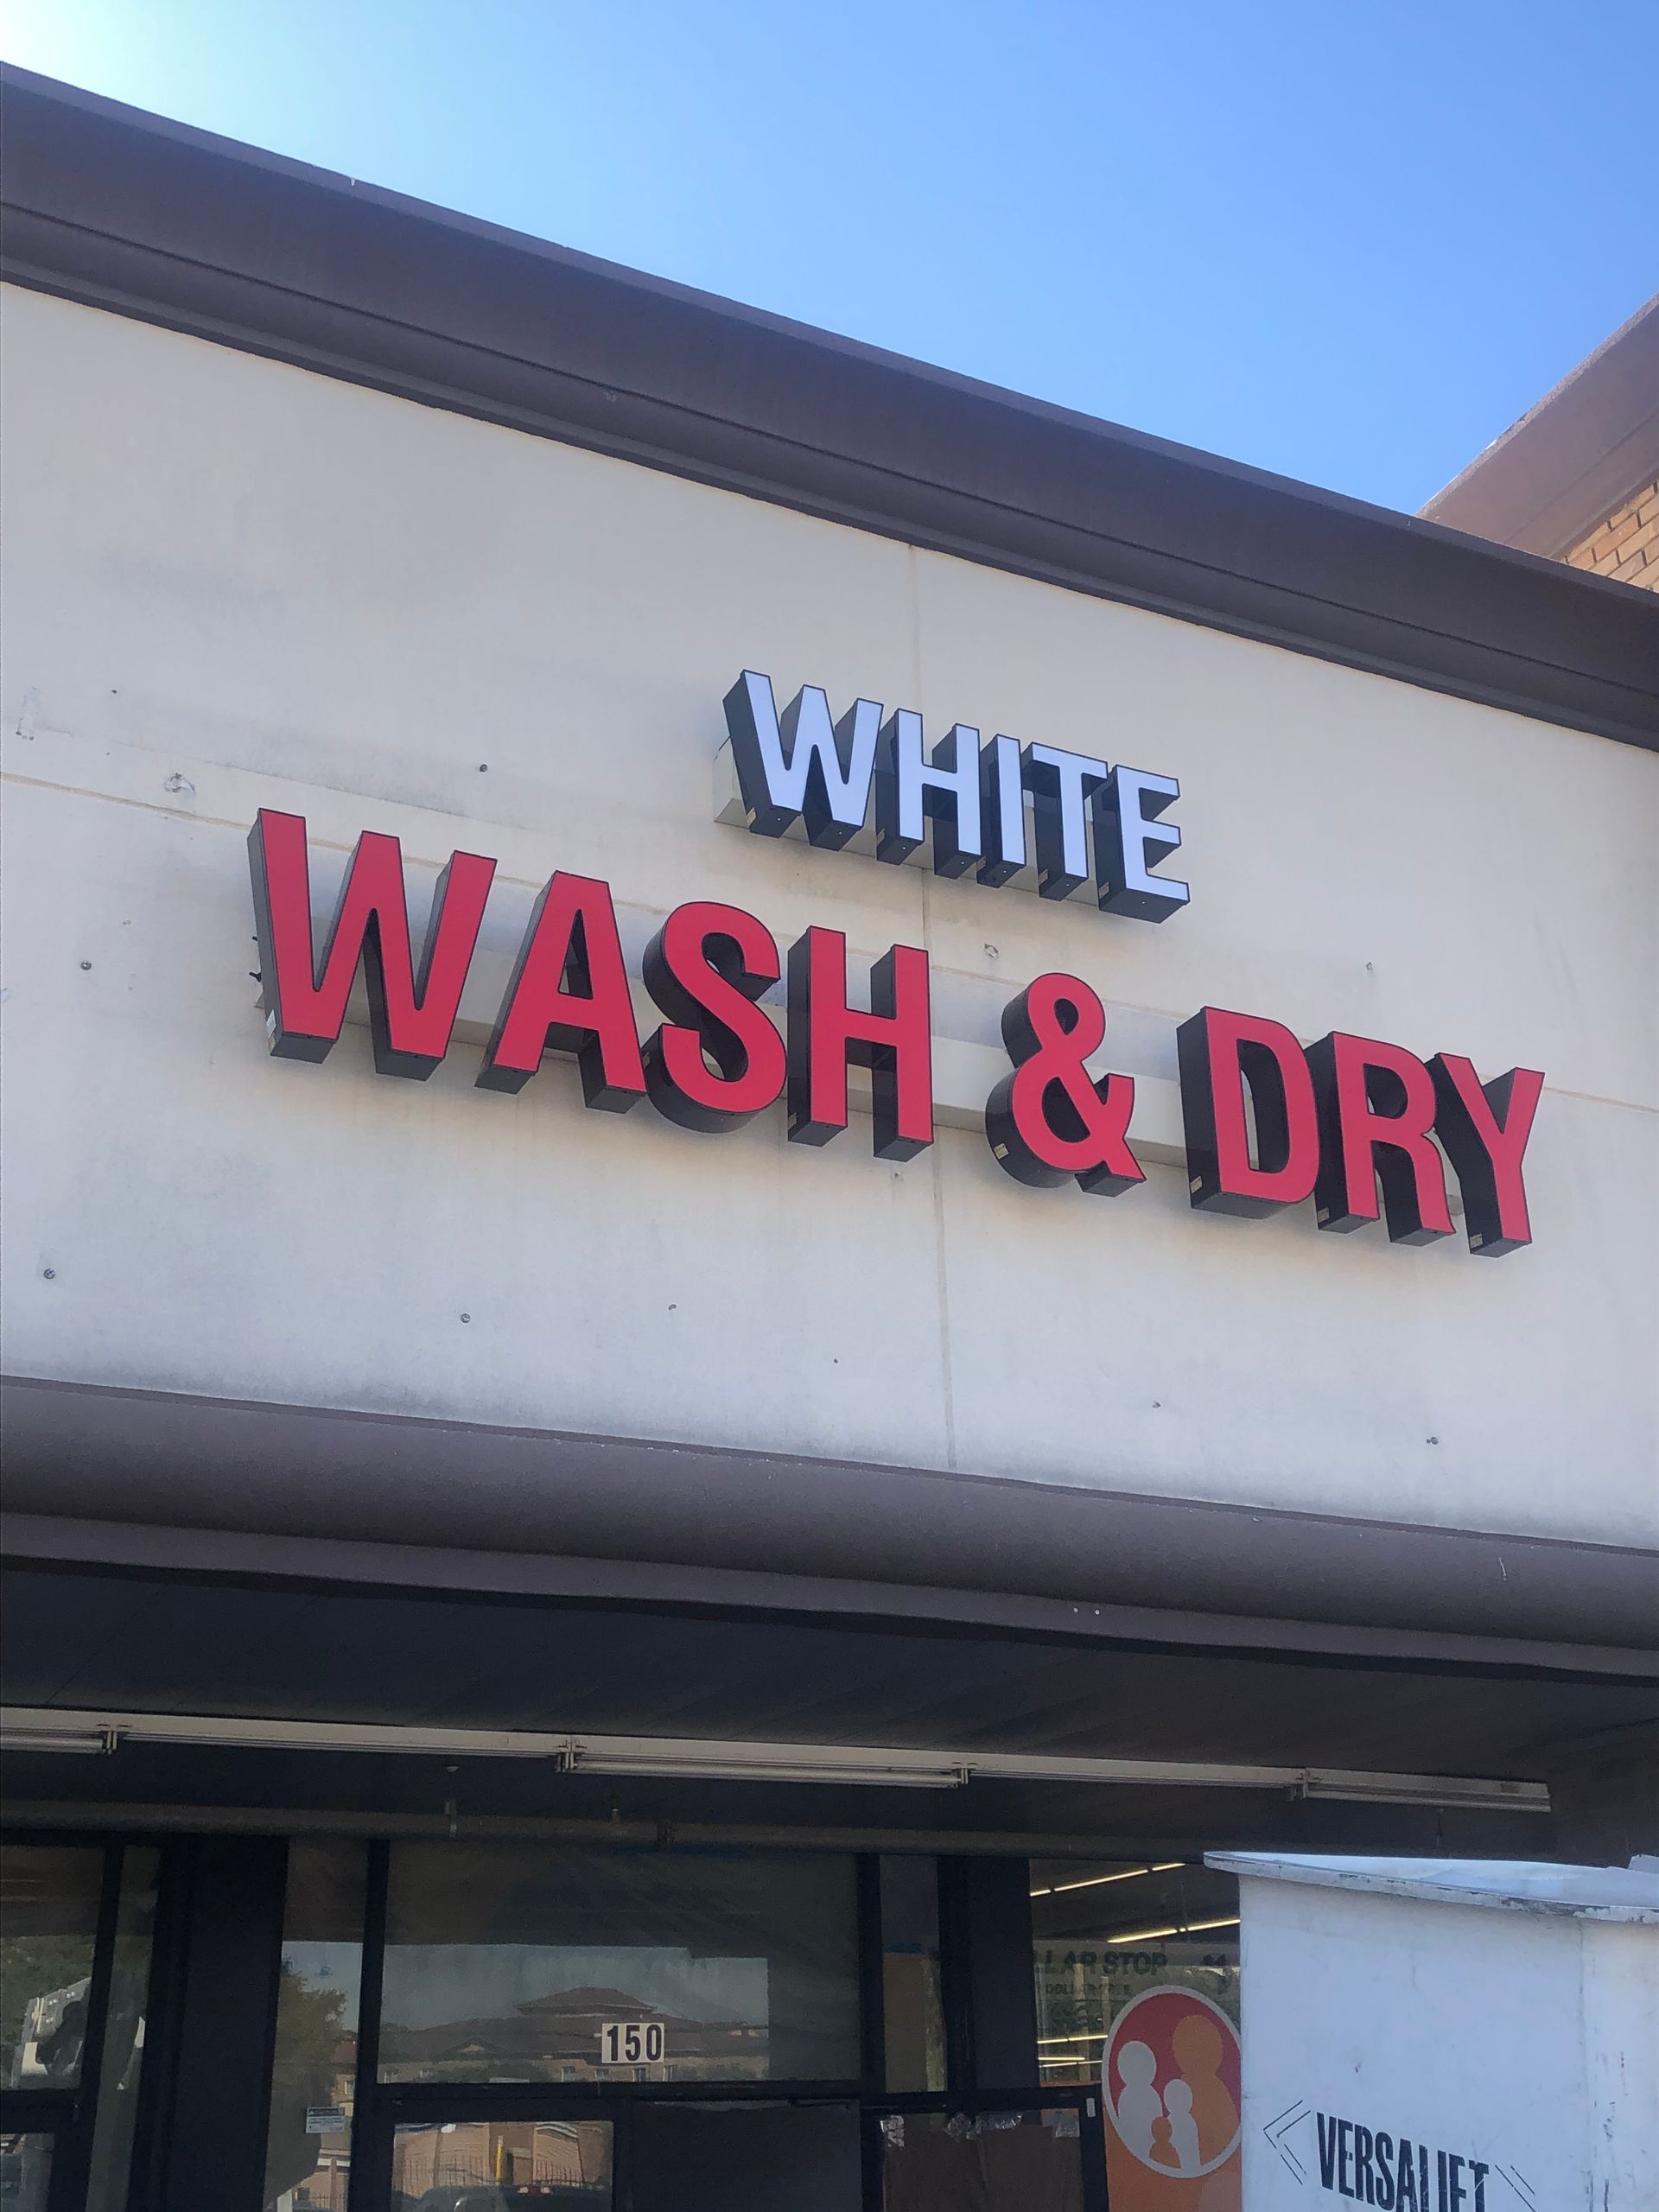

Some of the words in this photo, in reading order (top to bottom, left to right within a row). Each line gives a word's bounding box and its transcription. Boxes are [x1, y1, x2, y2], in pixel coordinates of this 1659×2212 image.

[742, 670, 1190, 904] WHITE
[258, 808, 934, 1145] WASH
[1012, 973, 1146, 1182] &
[1205, 1006, 1545, 1244] DRY
[1103, 1950, 1168, 1975] STOP
[607, 2024, 662, 2062] 150
